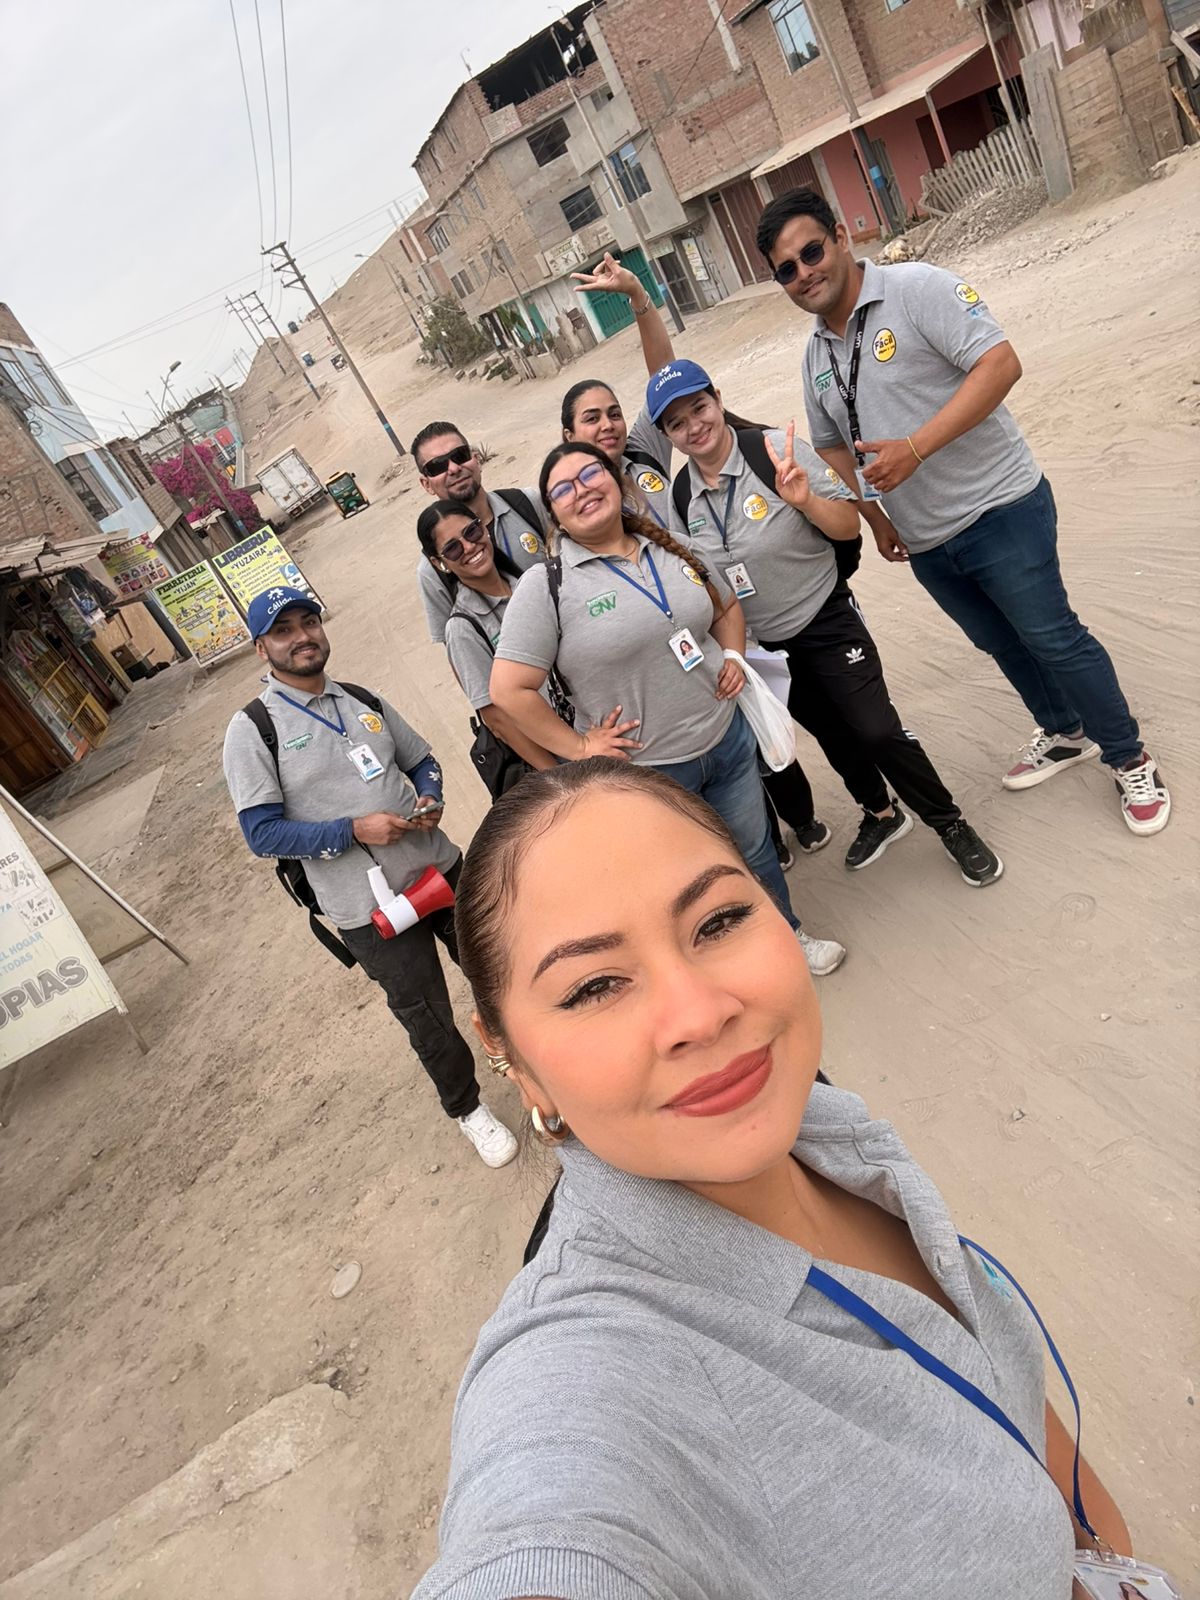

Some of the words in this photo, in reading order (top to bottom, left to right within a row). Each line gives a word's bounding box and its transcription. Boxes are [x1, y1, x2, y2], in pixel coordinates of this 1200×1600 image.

[874, 334, 893, 351] Fácil
[215, 530, 273, 568] LIBRERIA
[157, 564, 206, 594] FERRETERIA
[589, 596, 616, 617] GNV
[0, 852, 19, 870] RES
[9, 931, 44, 958] HOGAR
